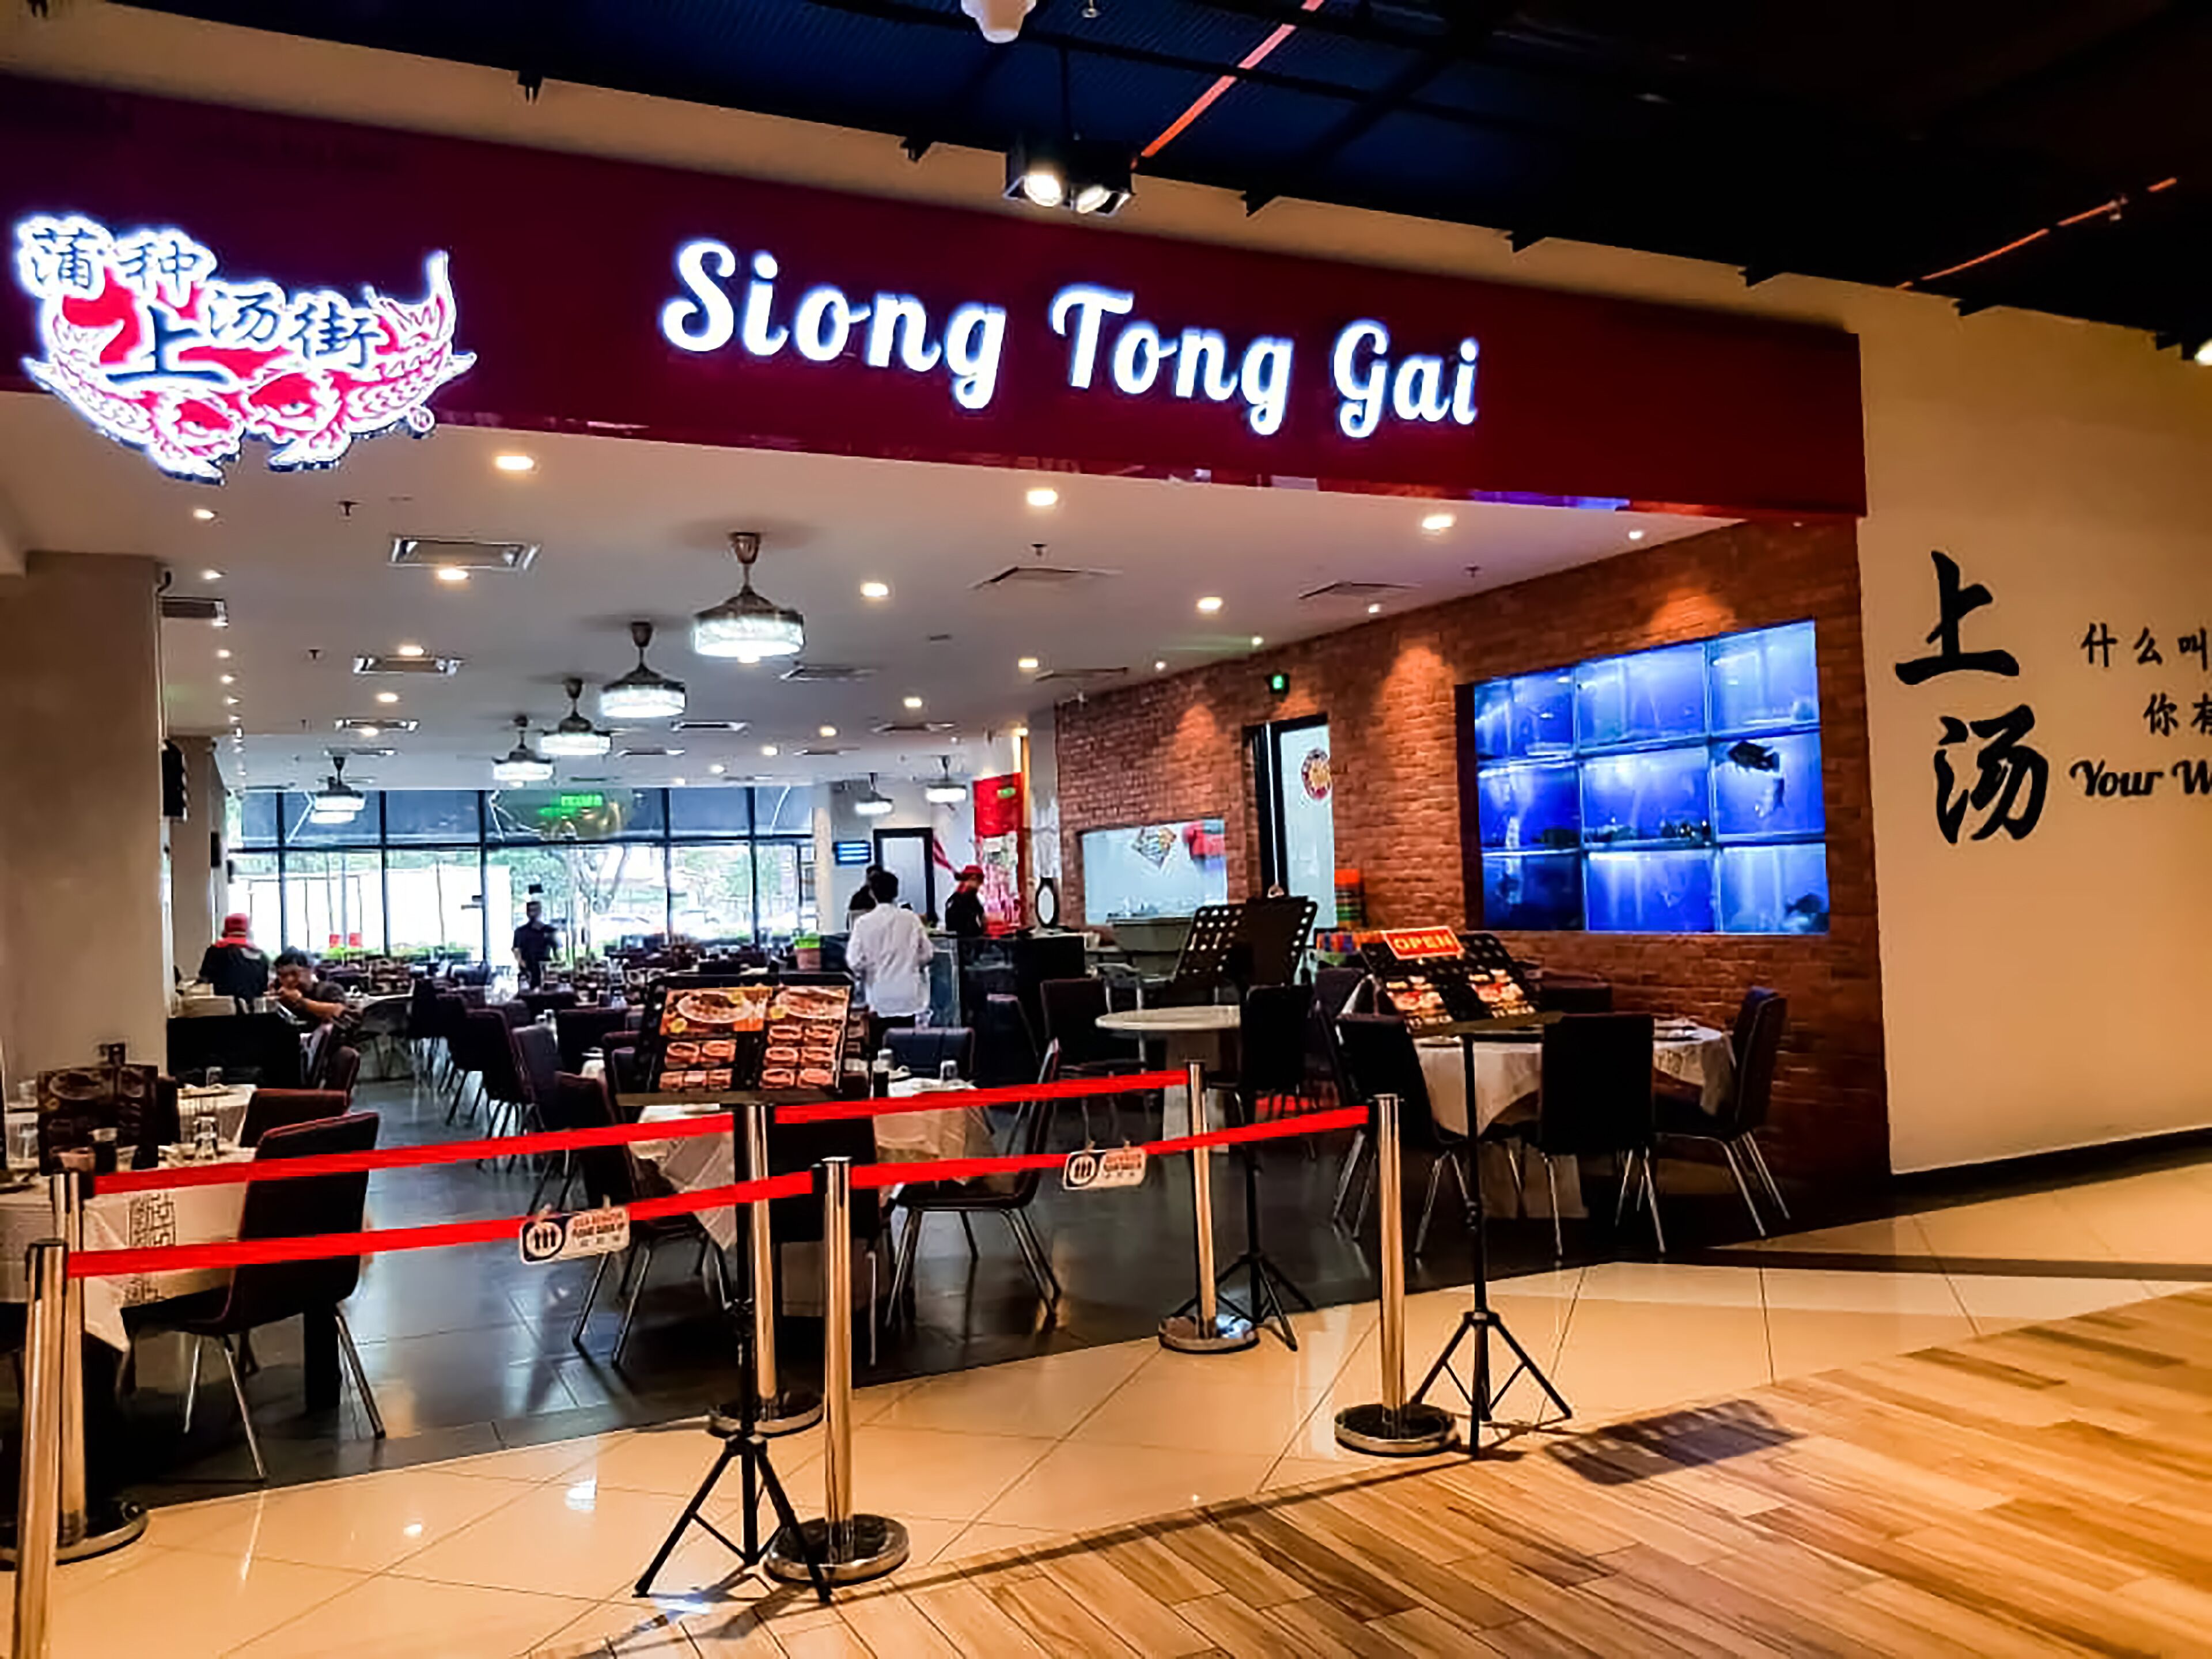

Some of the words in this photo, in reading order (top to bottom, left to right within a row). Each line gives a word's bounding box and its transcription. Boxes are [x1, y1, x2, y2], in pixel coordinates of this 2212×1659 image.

[32, 227, 200, 290] 蒲种
[662, 240, 1006, 409] Siong
[1051, 286, 1293, 435] Tong
[1333, 320, 1479, 438] Gai
[2070, 759, 2164, 797] Your
[1393, 935, 1455, 950] OPEN
